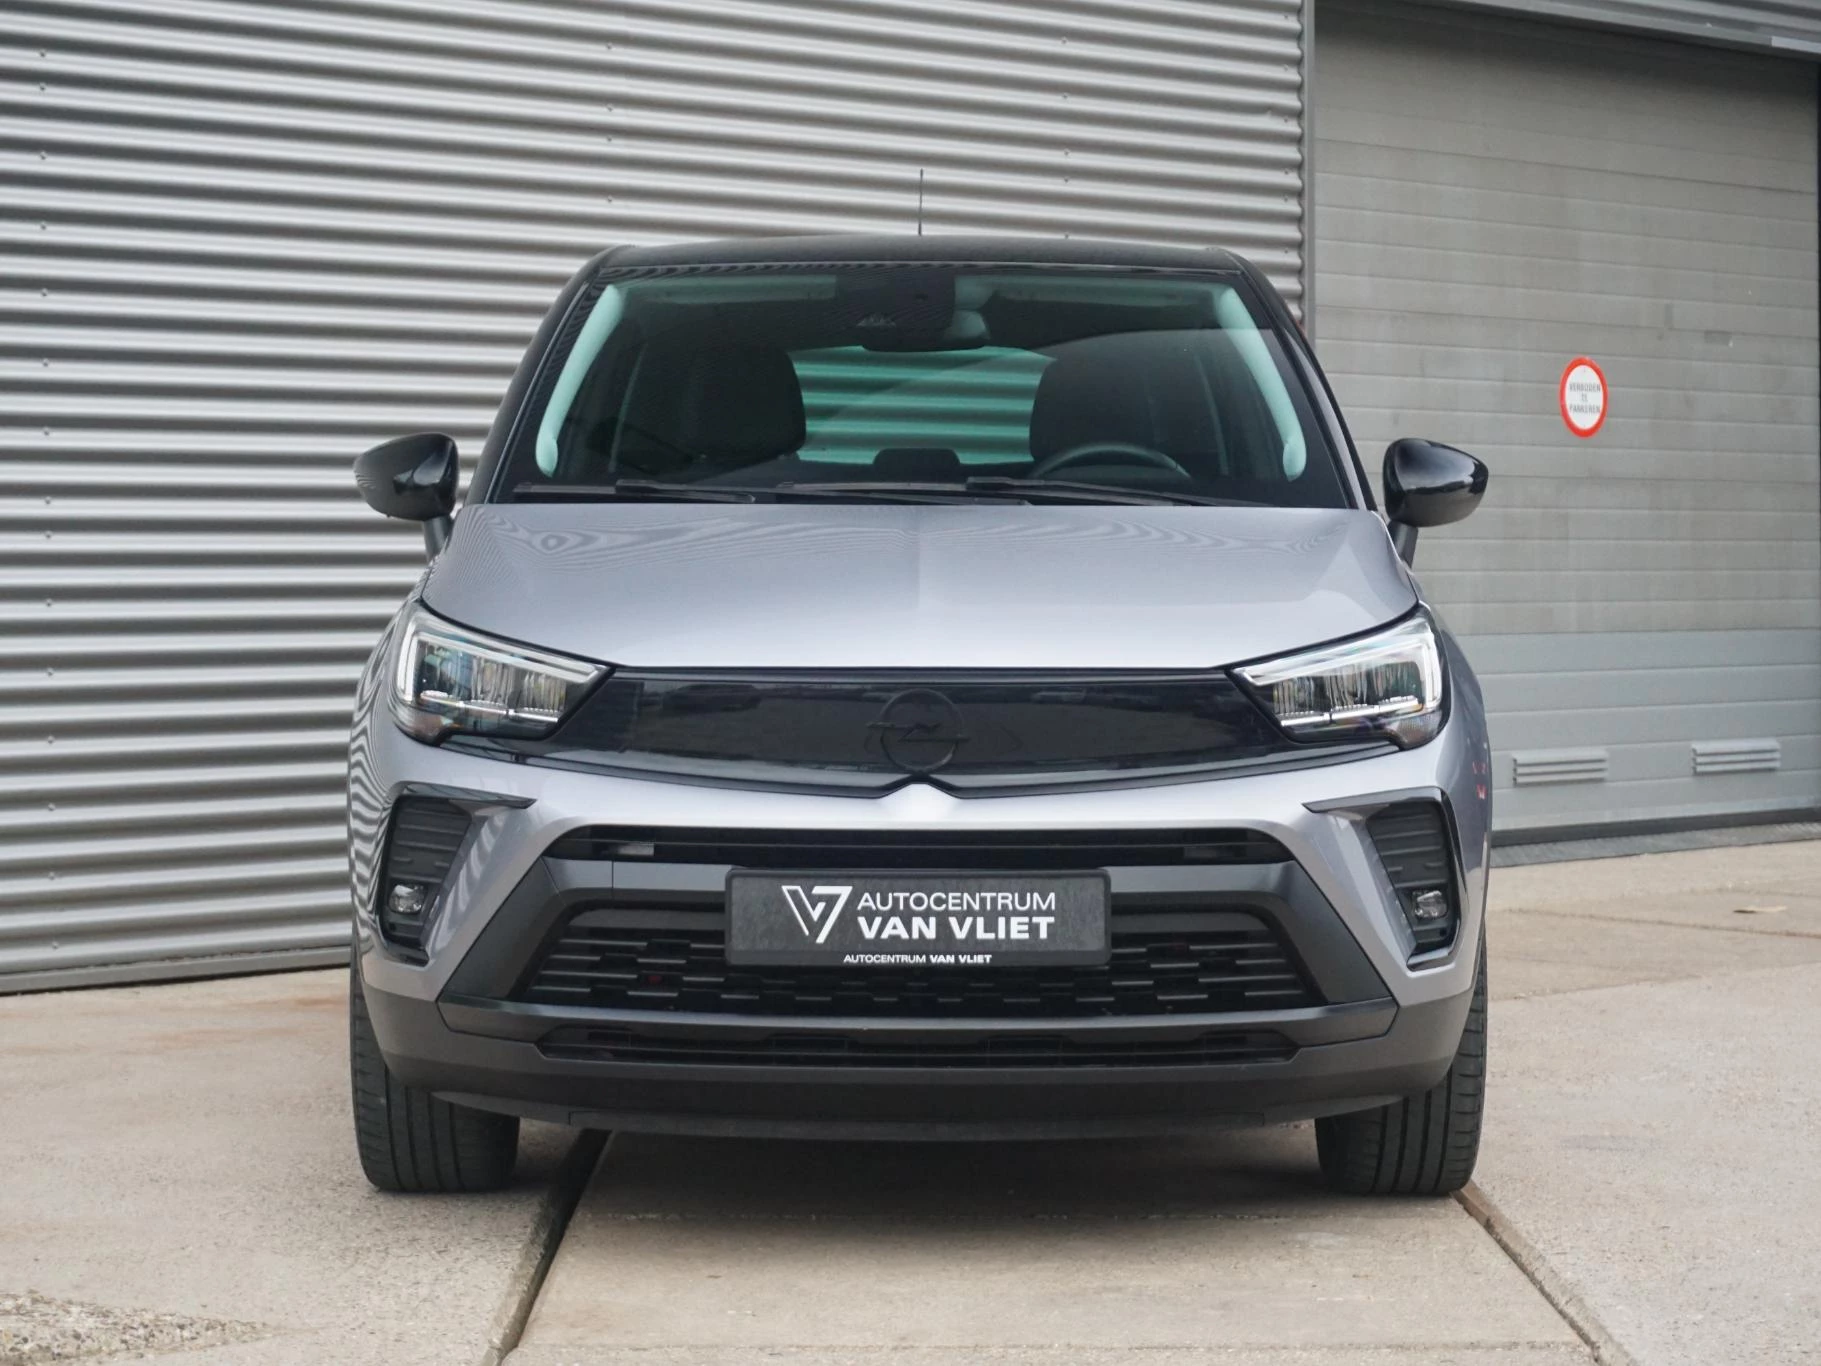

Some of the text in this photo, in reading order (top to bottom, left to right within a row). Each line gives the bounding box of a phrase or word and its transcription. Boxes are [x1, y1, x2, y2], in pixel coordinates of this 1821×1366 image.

[857, 891, 1056, 912] AUTOCENTRUM
[857, 916, 1056, 940] VAN VLIET
[843, 954, 993, 964] AUTOCENTRUM VAN VLIET
